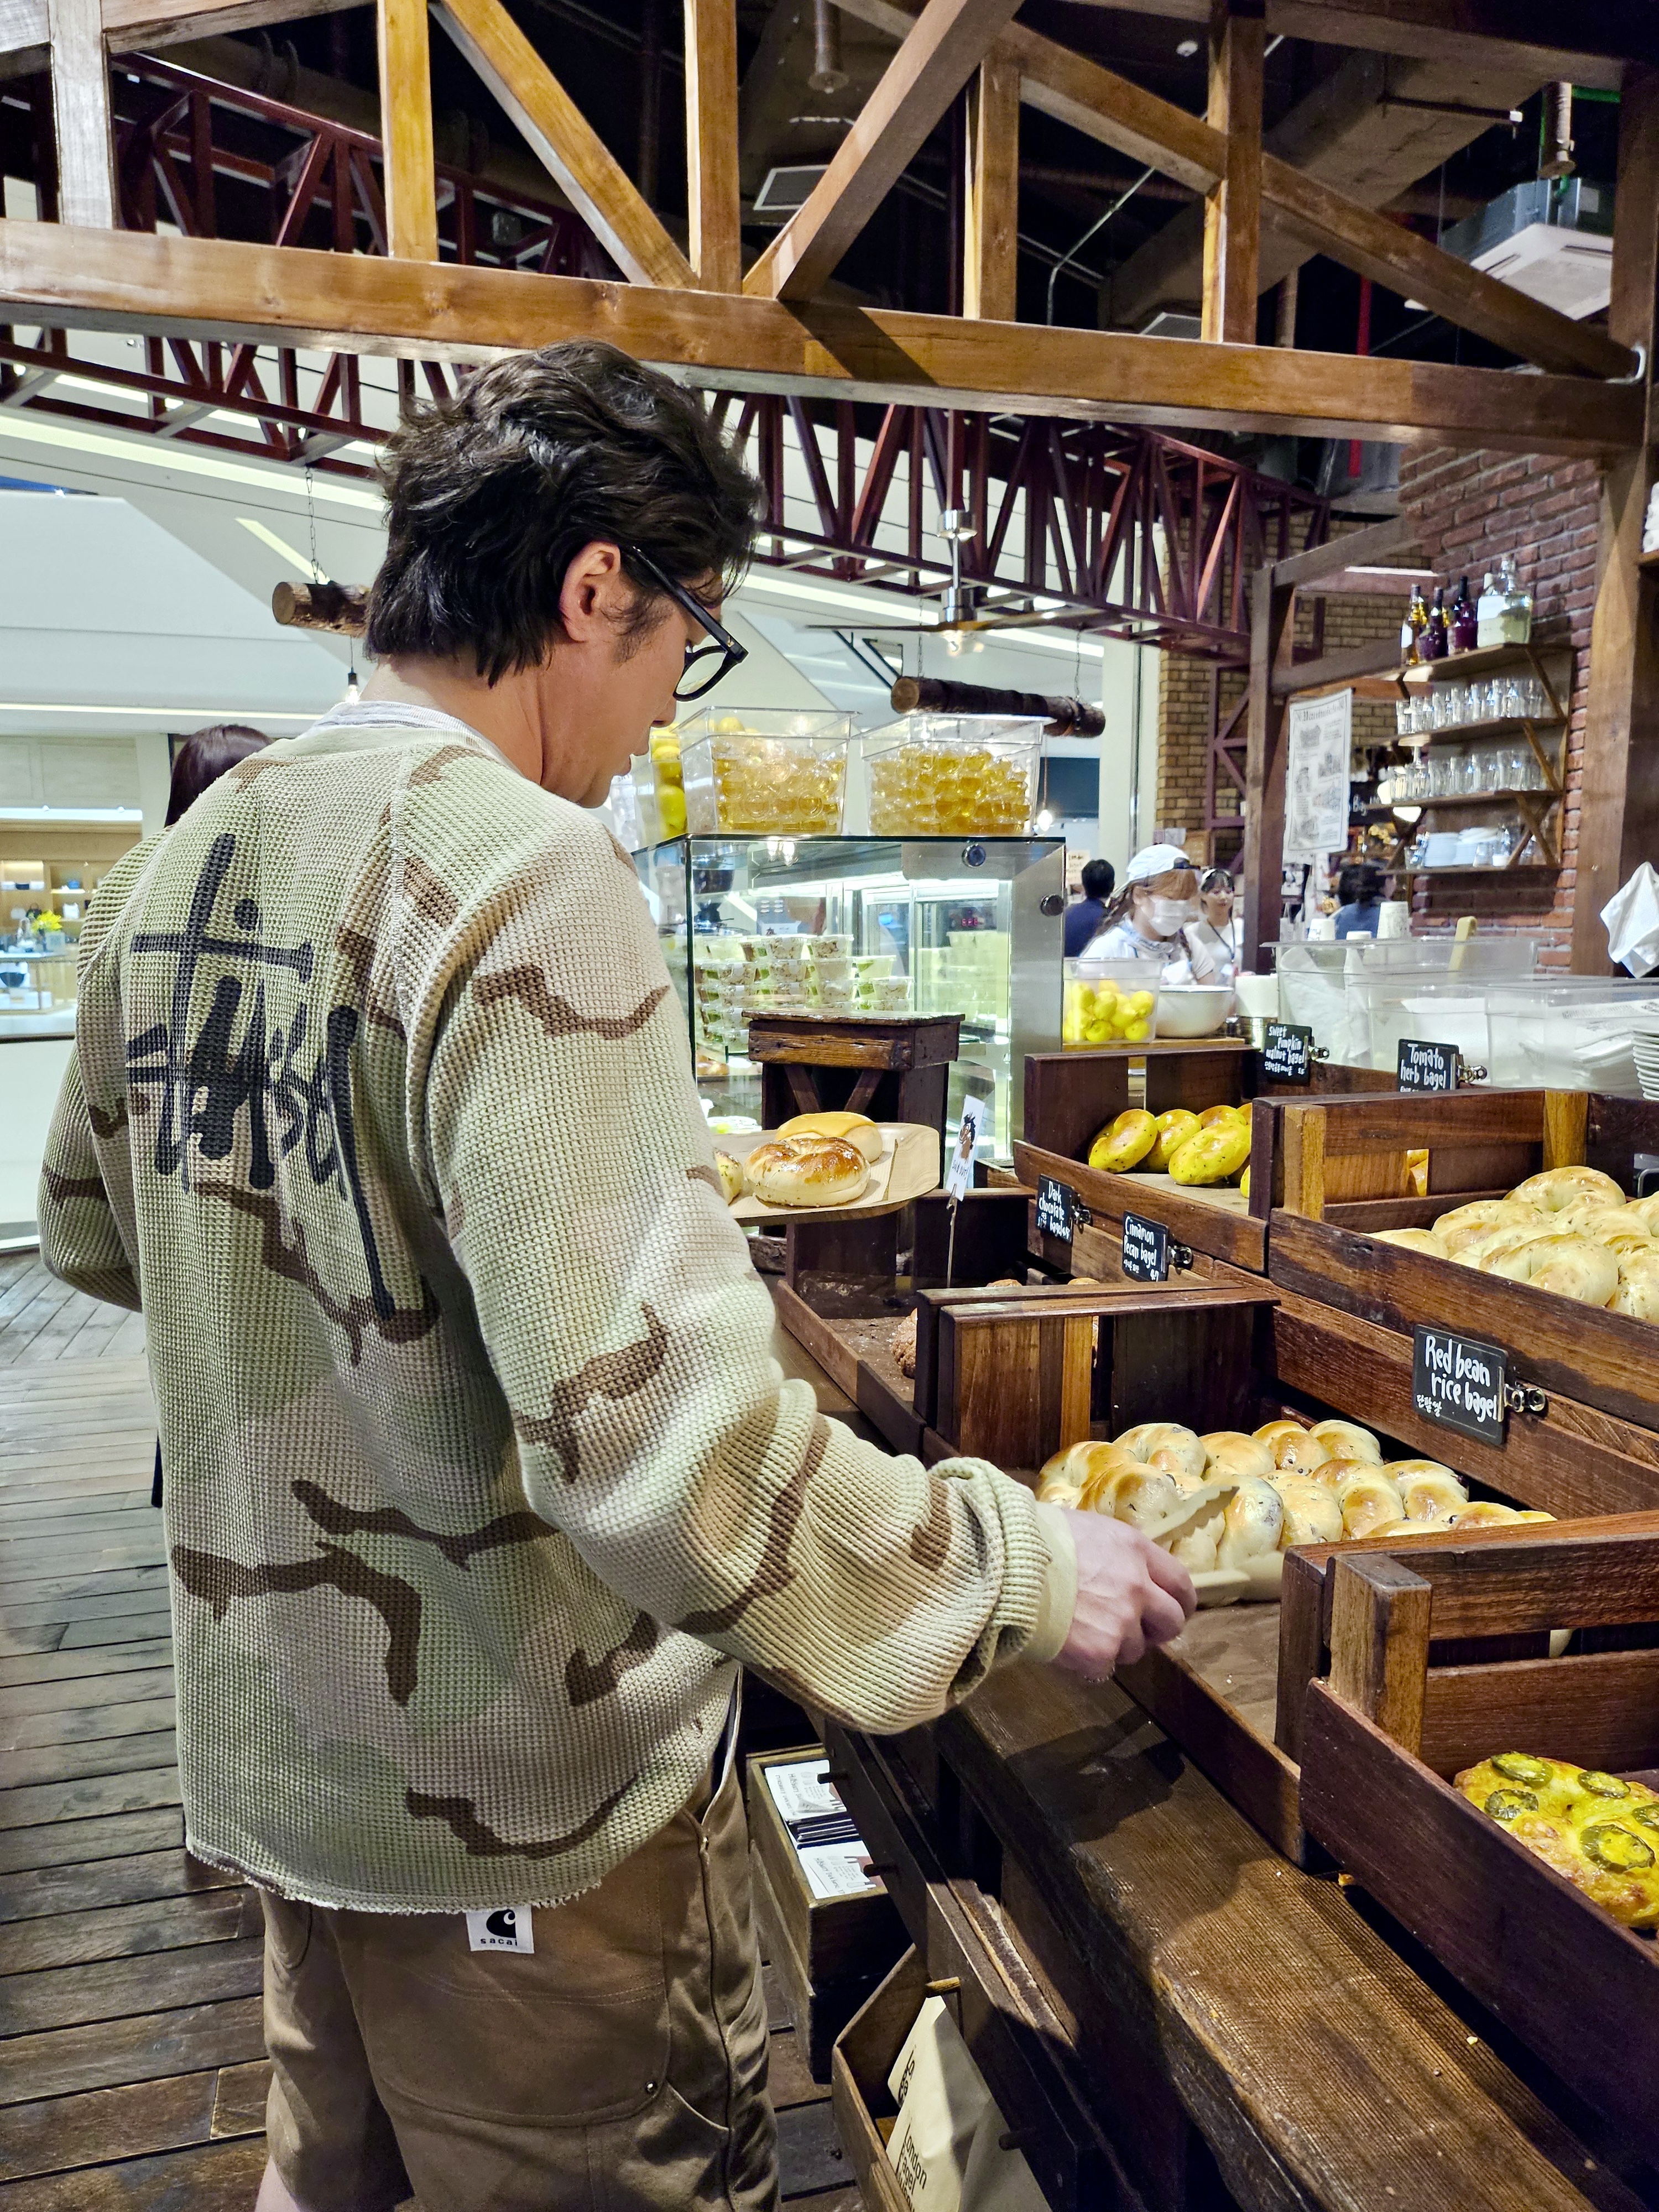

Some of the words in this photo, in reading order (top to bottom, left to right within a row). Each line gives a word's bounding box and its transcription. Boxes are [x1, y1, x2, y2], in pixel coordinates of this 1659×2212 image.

[1287, 1045, 1305, 1065] bagel
[1407, 1044, 1444, 1070] Tomato
[1400, 1059, 1420, 1084] herb
[1423, 1067, 1447, 1091] bagel
[1048, 1180, 1062, 1204] Dark
[1050, 1215, 1063, 1237] bagel
[1125, 1215, 1154, 1245] Cinnamon
[1124, 1234, 1139, 1259] Pecan
[1140, 1243, 1157, 1269] bagel
[1425, 1335, 1453, 1374] Red
[1455, 1344, 1490, 1387] bean
[1416, 1394, 1442, 1417] 단팥쌀
[1431, 1372, 1462, 1405] rice
[1465, 1381, 1498, 1423] bagel
[480, 1938, 518, 1947] sacai
[904, 2122, 927, 2190] London
